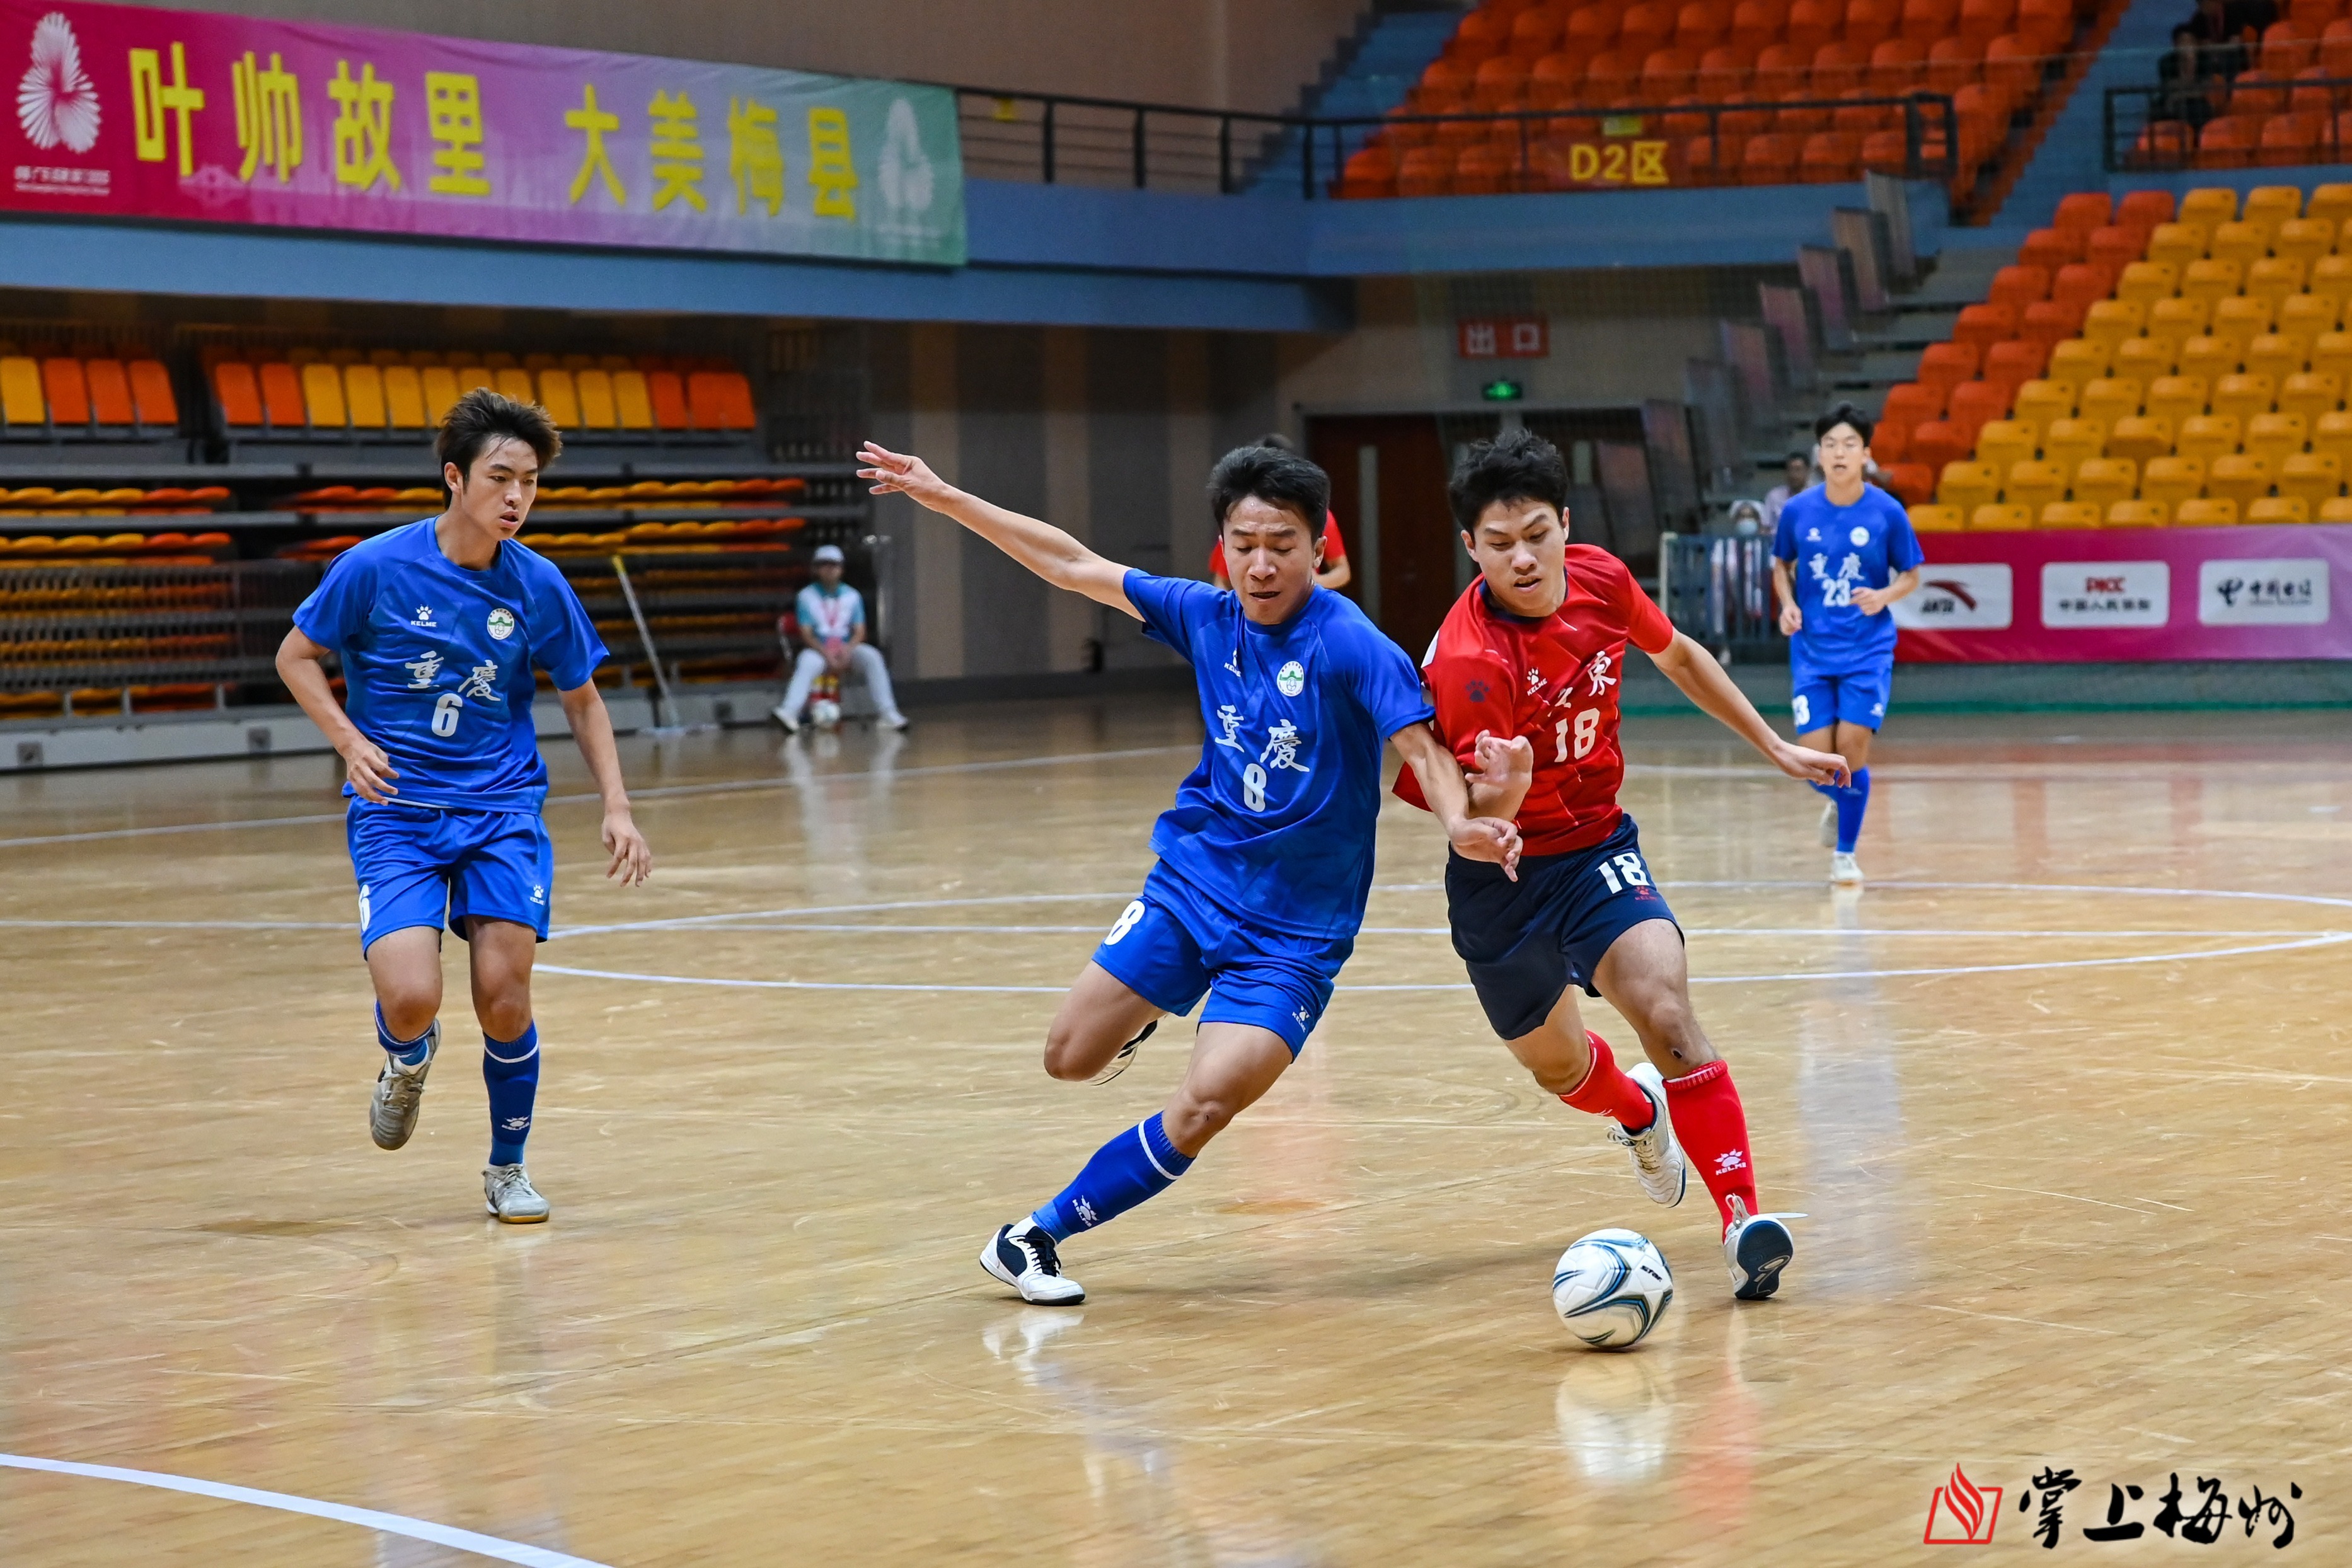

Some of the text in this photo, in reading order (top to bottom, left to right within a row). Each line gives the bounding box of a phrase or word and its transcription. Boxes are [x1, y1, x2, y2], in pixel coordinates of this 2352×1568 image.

[129, 41, 858, 222] 叶帅故里 大美梅县
[1569, 141, 1669, 184] D2区
[1465, 322, 1540, 356] 出口
[1821, 578, 1851, 608] 23
[1526, 677, 1548, 696] KELME
[431, 693, 463, 737] 6
[1554, 707, 1600, 763] 18
[1243, 763, 1267, 812] 8
[1594, 851, 1650, 894] 18
[358, 884, 371, 932] 6
[1104, 899, 1146, 946] 8
[1715, 1162, 1746, 1176] KELME
